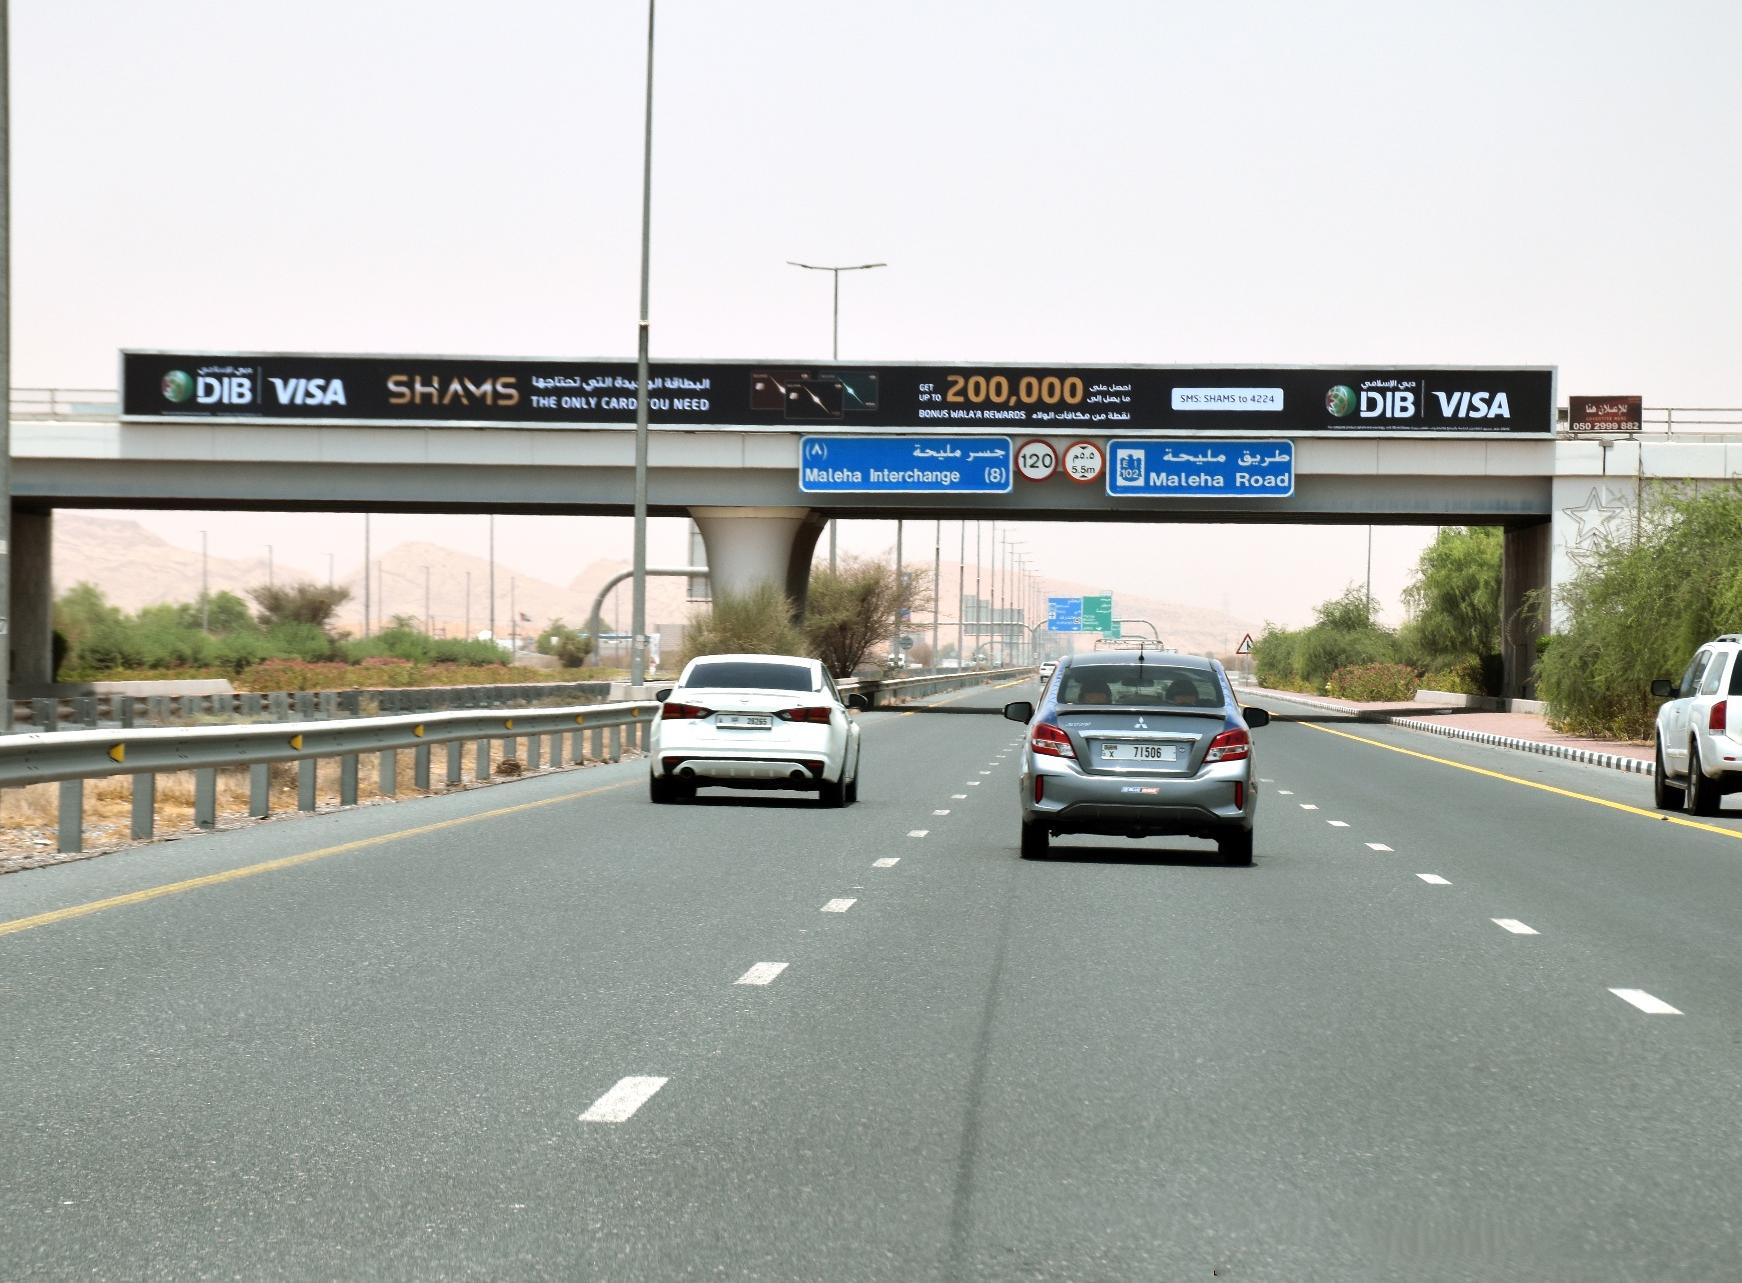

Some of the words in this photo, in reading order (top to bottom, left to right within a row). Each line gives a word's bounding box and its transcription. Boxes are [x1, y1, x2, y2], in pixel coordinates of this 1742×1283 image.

[531, 375, 581, 389] تحتاجها
[582, 376, 613, 391] التي
[614, 376, 663, 390] الويدة
[664, 377, 711, 391] البطاقة
[919, 383, 935, 391] GET
[196, 376, 253, 404] DIB
[267, 378, 347, 406] VISA
[386, 374, 520, 407] SHAMS
[918, 393, 930, 401] UP
[931, 394, 942, 402] TO
[946, 375, 1084, 406] 200,000
[530, 396, 558, 409] THE
[561, 396, 597, 409] ONLY
[601, 397, 638, 410] CARD
[646, 398, 670, 410] OU
[673, 398, 710, 411] NEED
[1180, 394, 1201, 403] SMS:
[1203, 394, 1236, 403] SHAMS
[1238, 395, 1248, 403] to
[1250, 395, 1275, 403] 4224
[1360, 391, 1416, 418] DIB
[1431, 391, 1511, 418] VISA
[918, 409, 949, 418] BONUS
[983, 410, 1026, 419] REWARDS
[1091, 412, 1107, 421] من
[1573, 422, 1592, 430] 050
[1593, 422, 1619, 430] 2999
[912, 443, 962, 460] مليحة
[965, 448, 1006, 462] جسر
[1163, 448, 1226, 465] مليحة
[1237, 450, 1290, 466] طريق
[1021, 453, 1053, 469] 120
[805, 468, 862, 483] Maleha
[869, 468, 960, 485] Interchange
[984, 467, 1006, 483] (8)
[1071, 465, 1096, 474] 5.5m
[1121, 469, 1139, 478] 102
[1149, 472, 1224, 487] Maleha
[1235, 472, 1289, 487] Road
[1133, 747, 1162, 758] 71506
